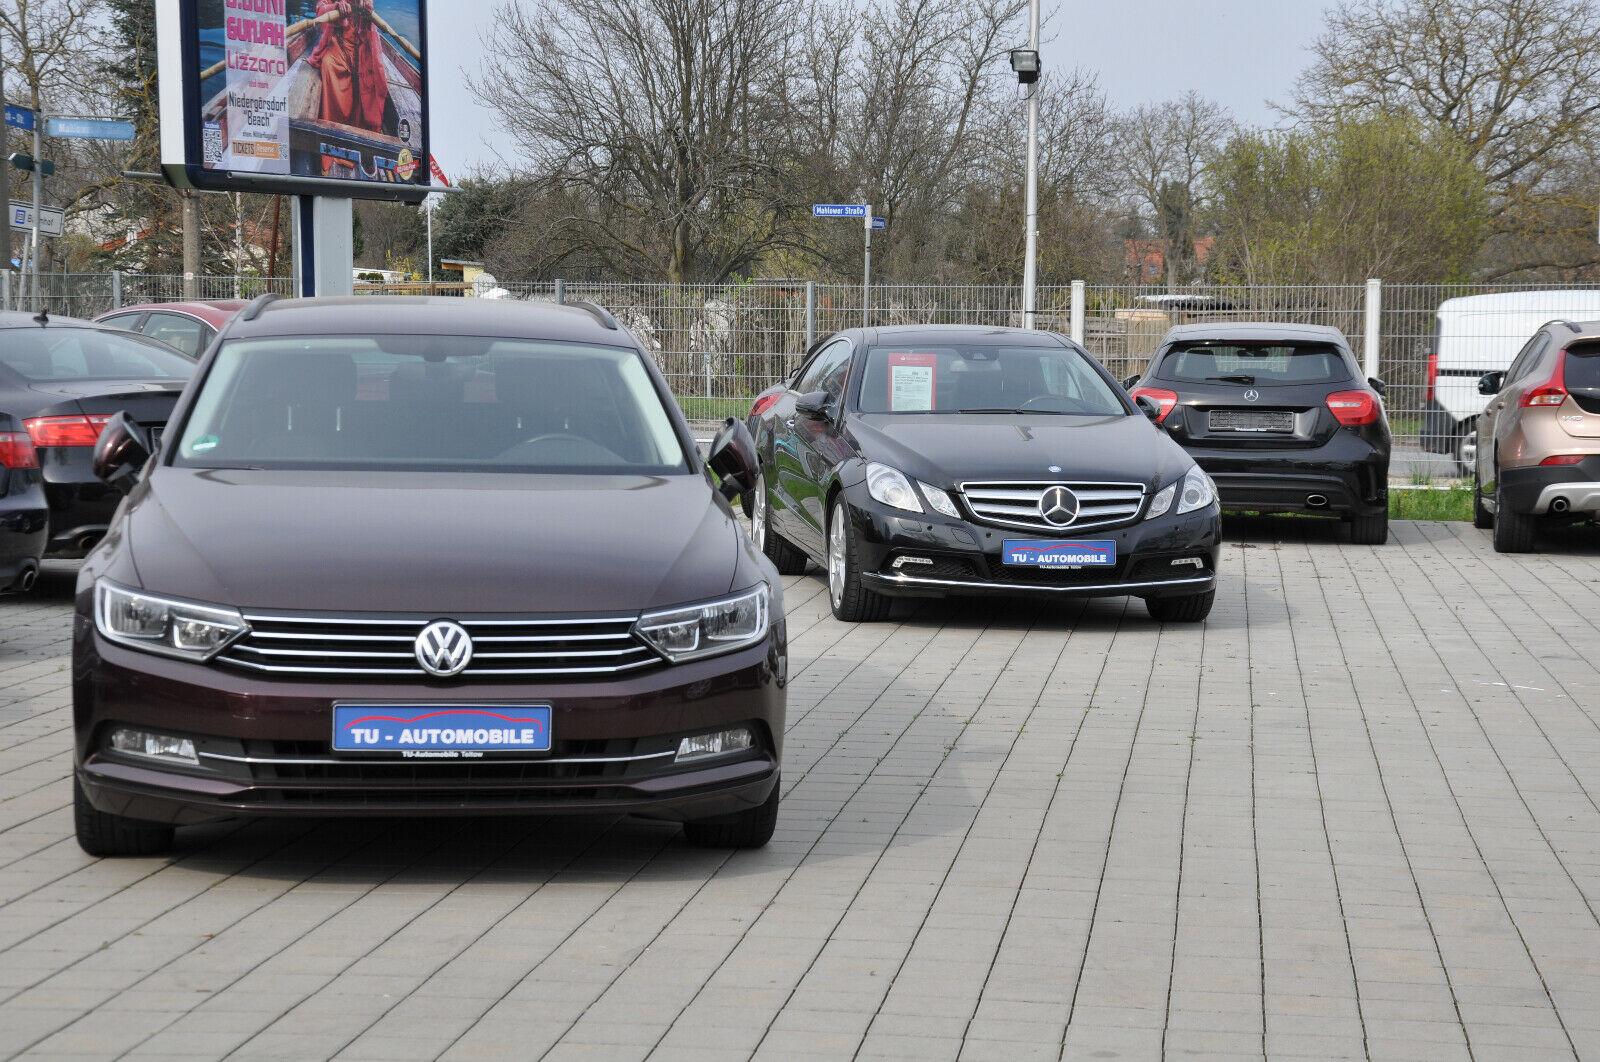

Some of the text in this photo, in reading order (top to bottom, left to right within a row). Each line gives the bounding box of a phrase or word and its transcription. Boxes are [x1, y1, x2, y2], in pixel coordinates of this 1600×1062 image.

[232, 142, 255, 154] TICKETS
[816, 206, 864, 215] Mahlower Straße
[1012, 553, 1026, 562] TU
[1037, 554, 1107, 563] AUTOMOBILE
[351, 728, 380, 744] TU
[398, 728, 535, 744] AUTOMOBILE
